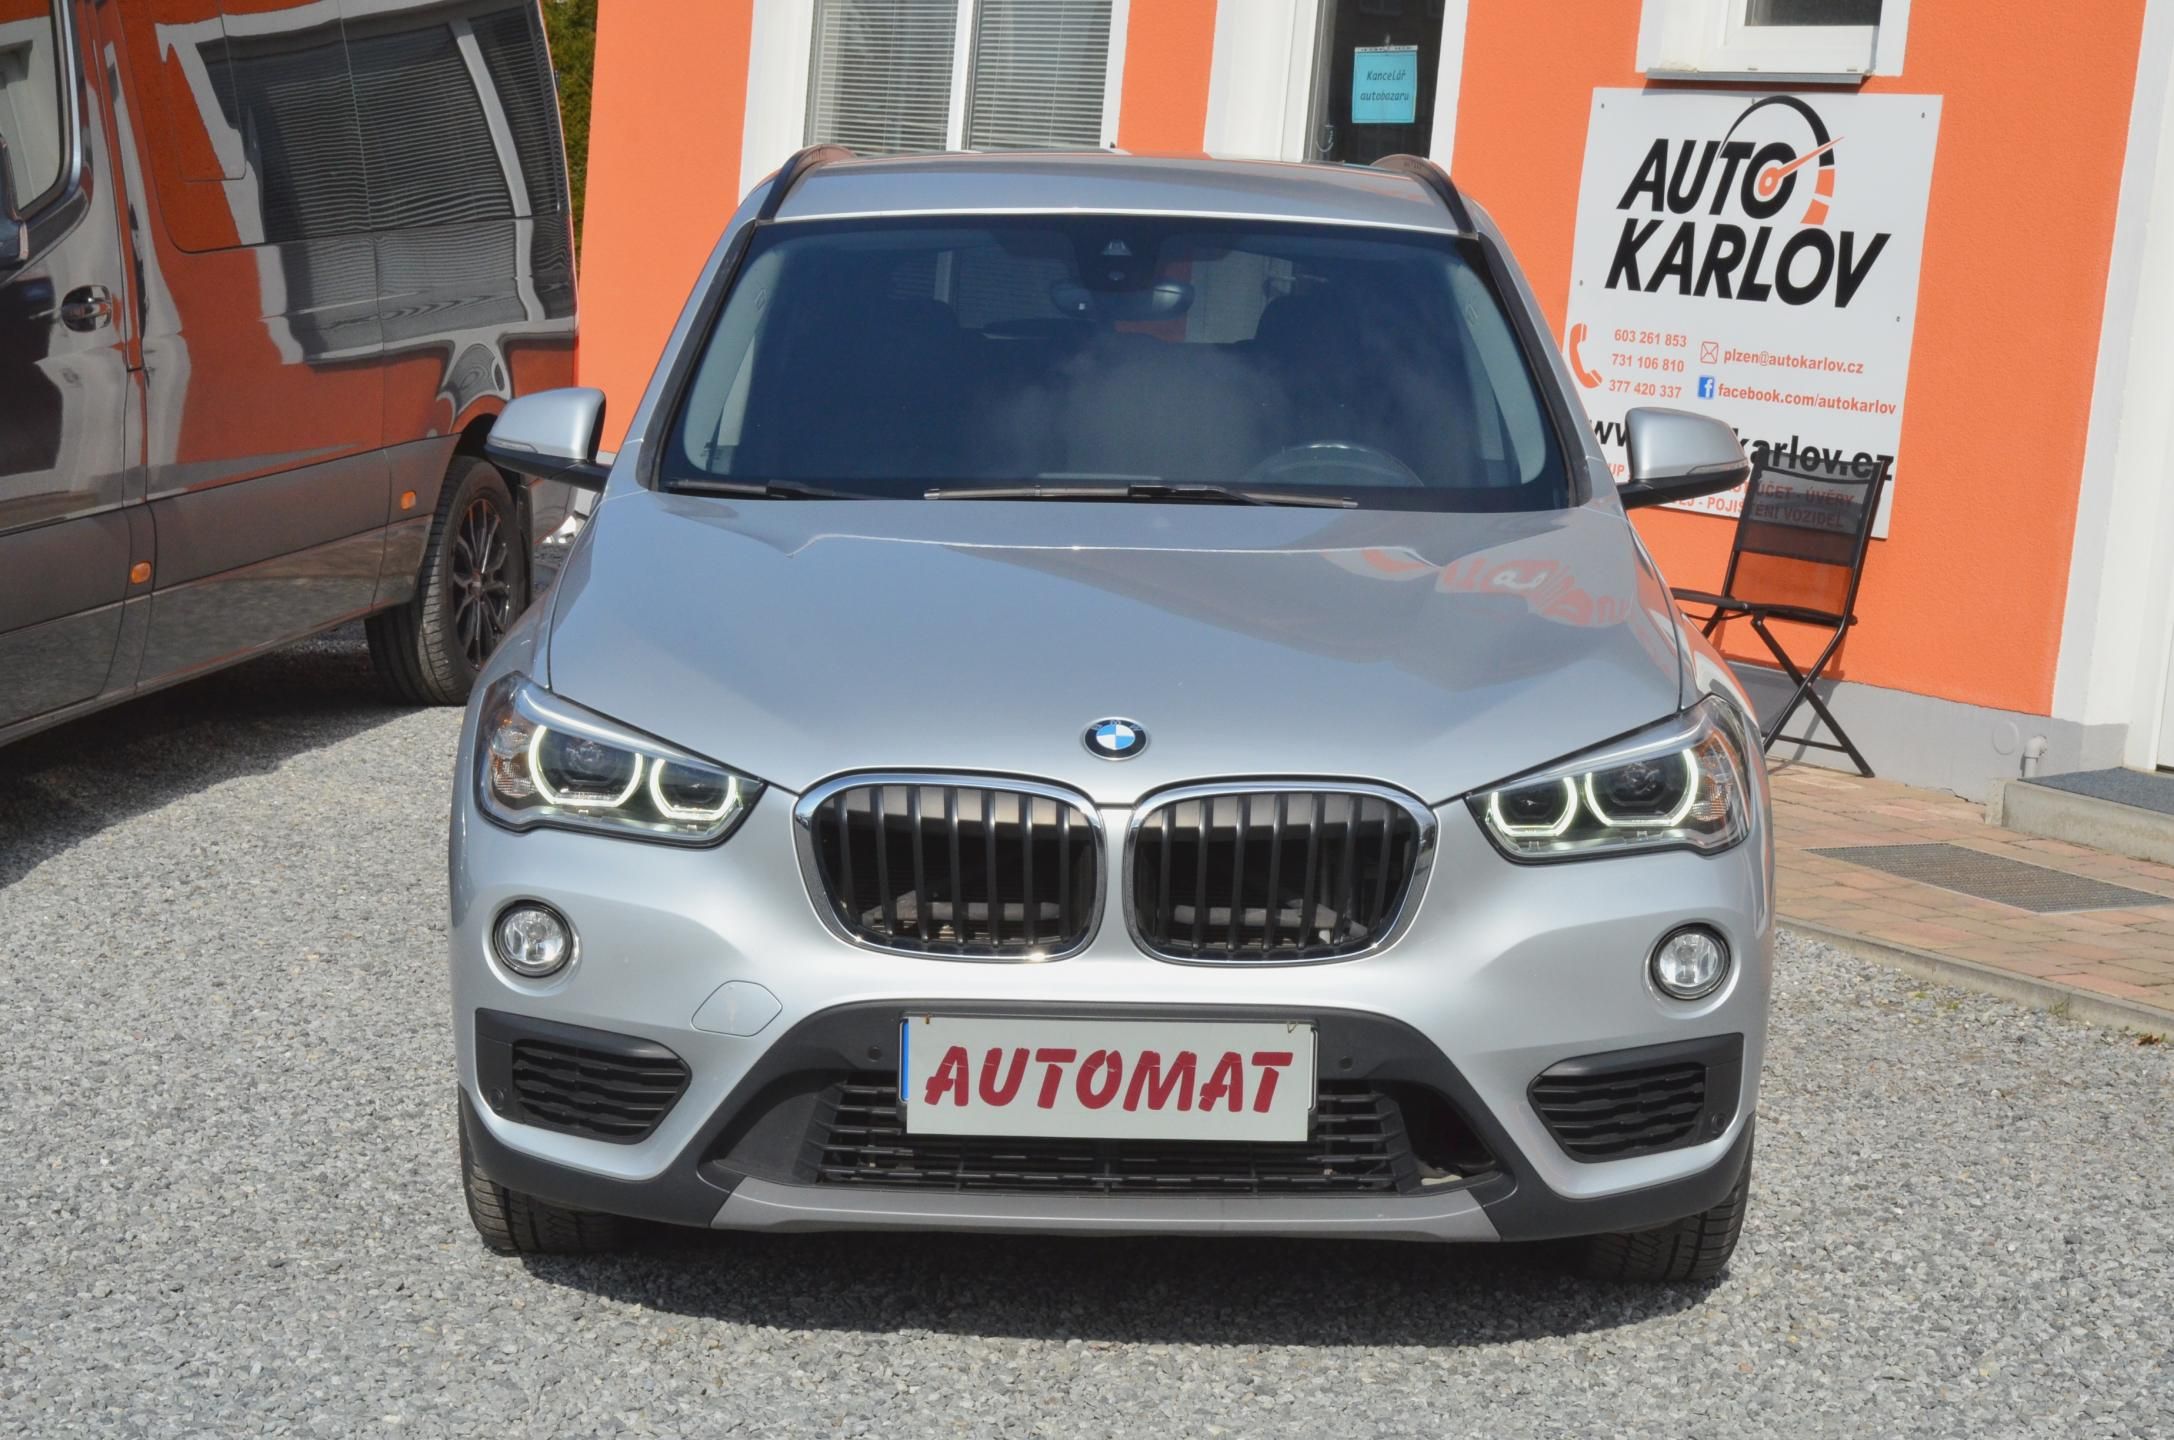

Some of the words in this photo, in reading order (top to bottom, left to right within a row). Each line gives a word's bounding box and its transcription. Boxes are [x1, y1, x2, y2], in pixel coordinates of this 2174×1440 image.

[1360, 90, 1409, 101] autobazaru
[1616, 138, 1798, 219] AUTO
[1604, 218, 1892, 308] KARLOV
[1614, 329, 1636, 342] 603
[1640, 331, 1661, 344] 261
[1664, 334, 1687, 347] 853
[1611, 353, 1633, 367] 731
[1638, 356, 1659, 370] 106
[1662, 359, 1684, 373] 810
[1723, 349, 1864, 374] plzen@autokarlov.cz
[1609, 379, 1631, 393] 377
[1634, 382, 1656, 396] 420
[1660, 385, 1682, 399] 337
[1718, 383, 1897, 415] facebook.com/autokarlov
[924, 1045, 1294, 1114] AUTOMAT
